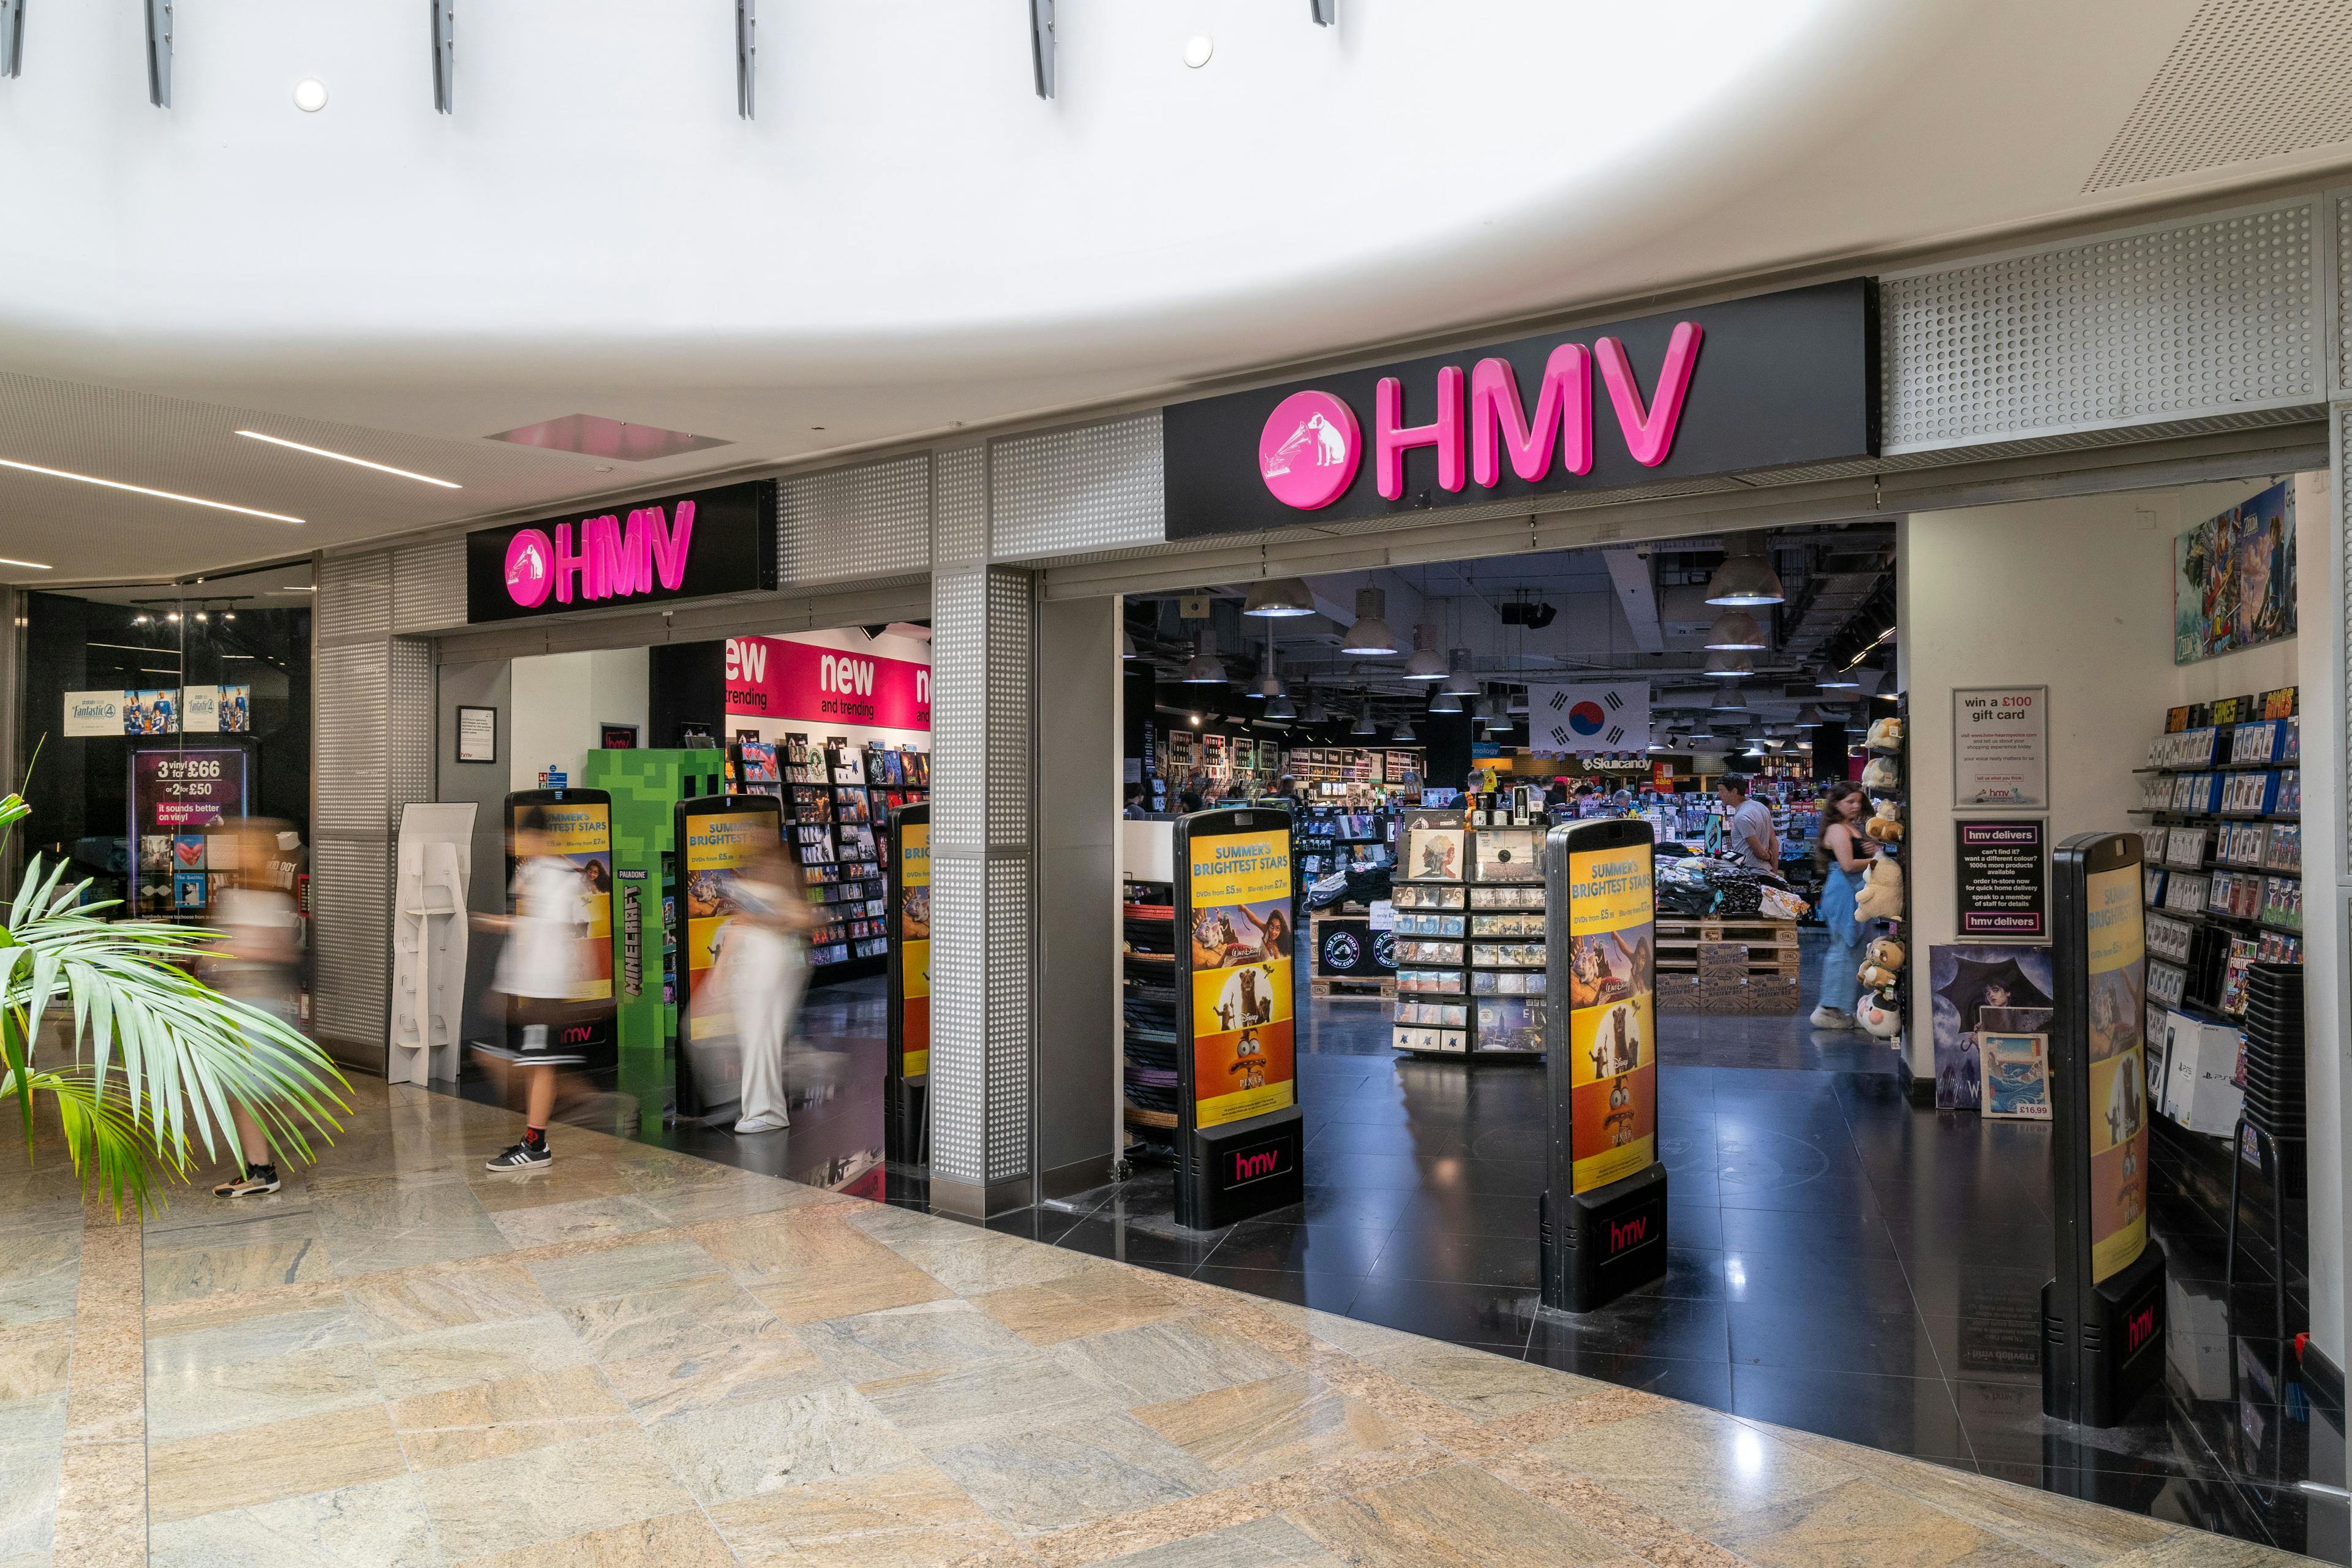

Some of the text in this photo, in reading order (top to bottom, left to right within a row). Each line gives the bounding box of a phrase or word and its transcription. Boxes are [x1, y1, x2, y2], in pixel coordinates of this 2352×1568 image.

[1376, 321, 1703, 500] HMV
[556, 500, 696, 605] HMV
[821, 654, 874, 696] new
[821, 698, 874, 720] and trending
[1965, 697, 1986, 707] win
[2002, 696, 2032, 706] £100
[917, 710, 930, 722] and
[1972, 710, 2024, 722] gift card
[158, 761, 220, 778] 3 vinyl for £66
[1593, 758, 1653, 771] Skullcandy
[173, 783, 180, 795] 2
[189, 783, 212, 795] £50
[170, 813, 187, 823] vinyl
[578, 822, 606, 831] STARS
[1992, 831, 2032, 839] delivers
[1215, 842, 1271, 859] SUMMER'S
[1194, 856, 1287, 876] BRIGHTEST STARS
[1592, 859, 1638, 879] SUMMER'S
[1572, 874, 1651, 899] BRIGHTEST STARS
[1971, 917, 2034, 925] hmv delivers
[624, 885, 643, 997] MINECRAFT
[1346, 935, 1358, 951] SHOP
[1330, 957, 1354, 967] HMV.COM
[1240, 1075, 1262, 1087] PIXAR
[1612, 1130, 1632, 1144] PIXAR
[1236, 1150, 1277, 1180] hmv
[1611, 1216, 1646, 1253] hmv
[2129, 1305, 2153, 1352] hmv
